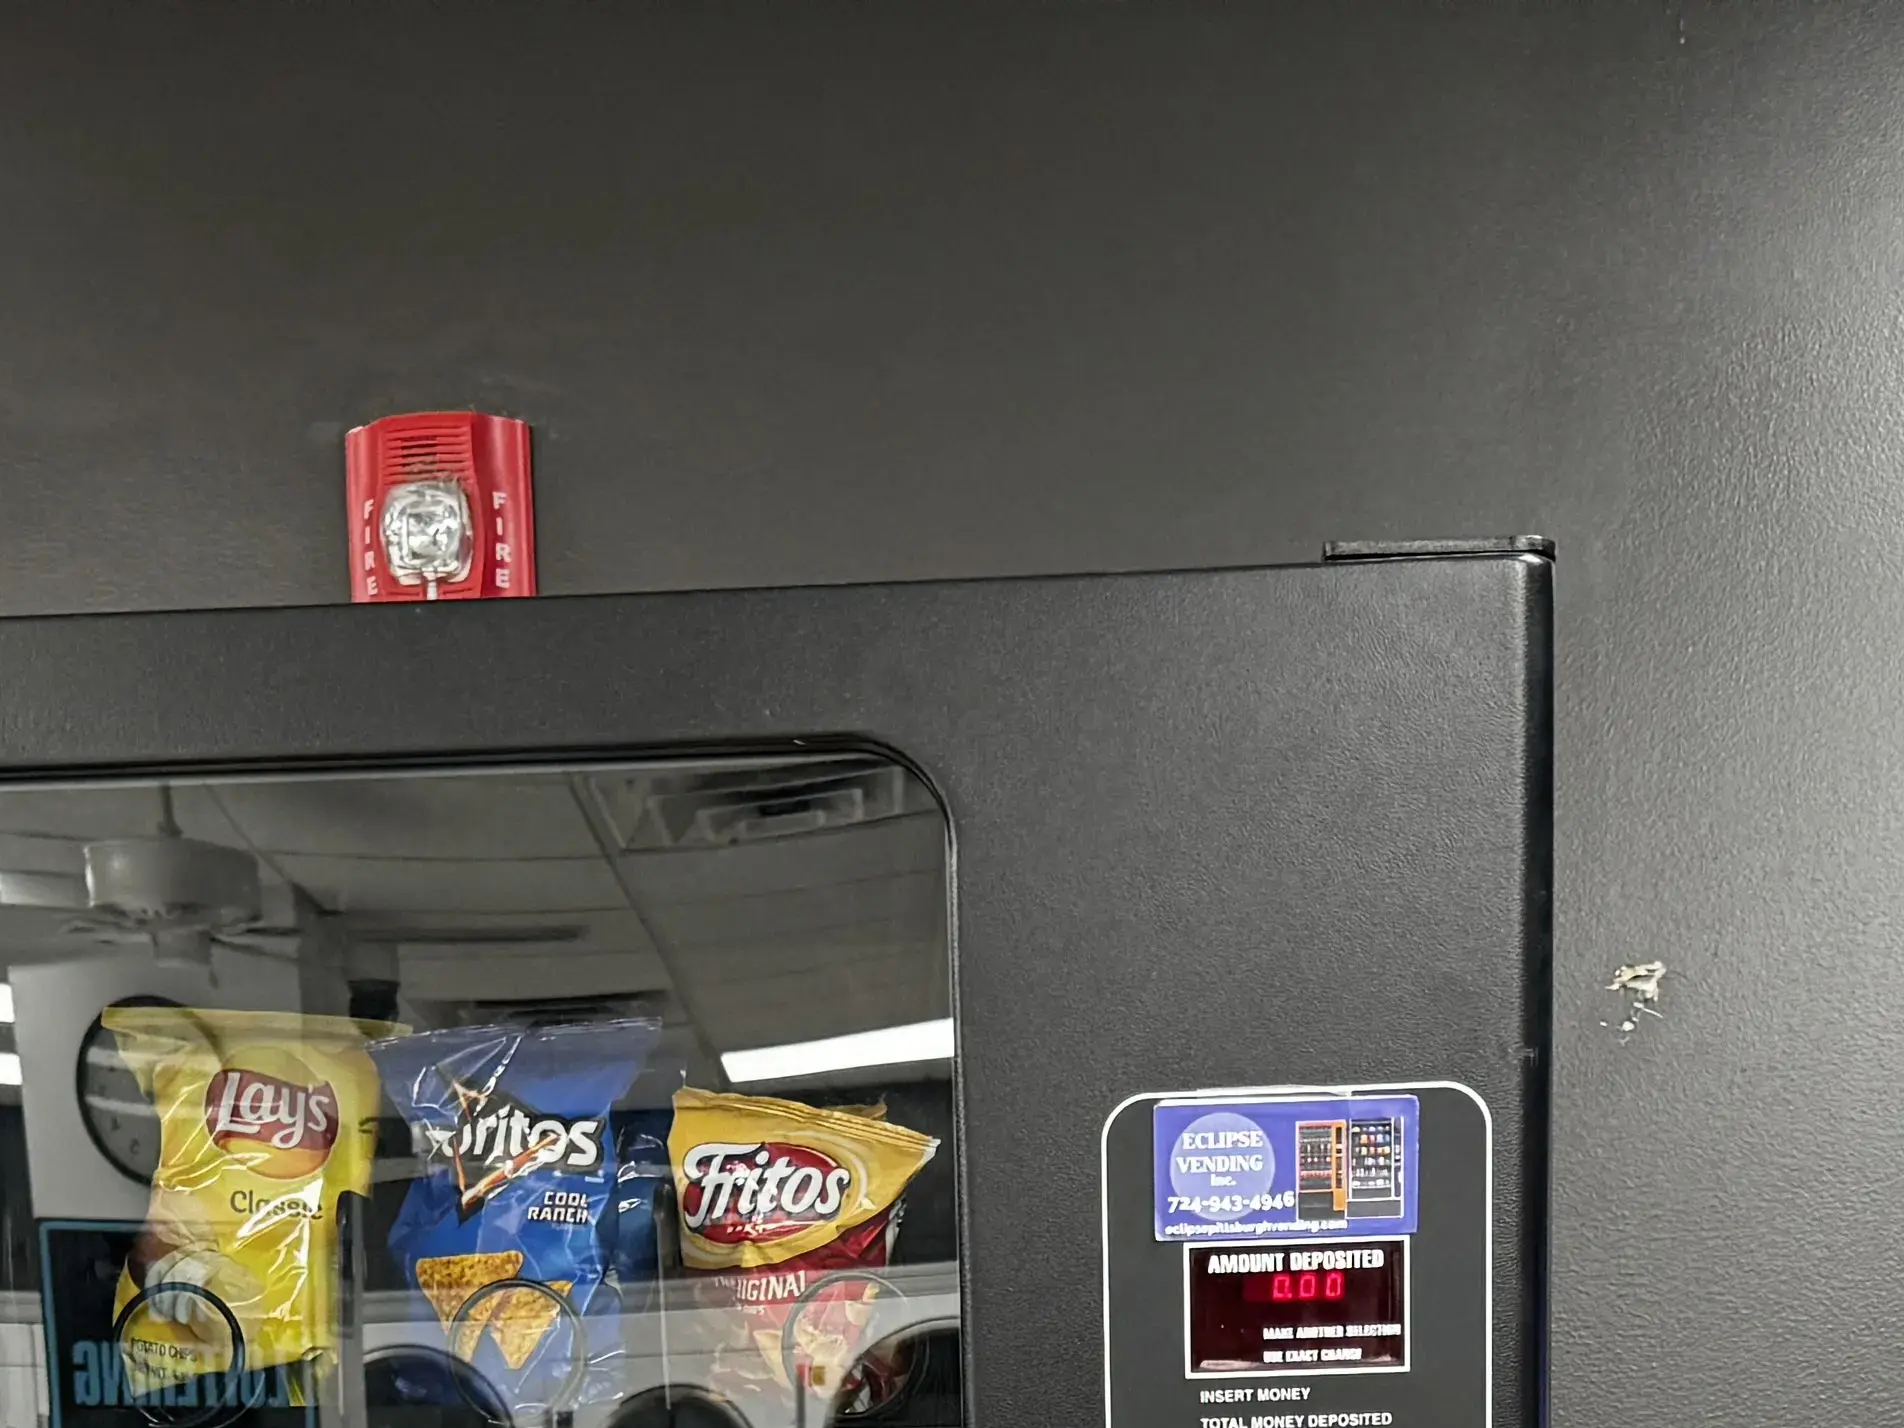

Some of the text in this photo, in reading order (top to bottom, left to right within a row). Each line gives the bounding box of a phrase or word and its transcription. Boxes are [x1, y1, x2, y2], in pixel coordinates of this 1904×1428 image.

[363, 499, 379, 596] FIRE
[492, 491, 512, 589] FIRE
[216, 1071, 330, 1149] Lay's
[1182, 1130, 1264, 1151] ECLIPSE
[1176, 1155, 1264, 1174] VENDING
[683, 1141, 850, 1228] Fritos
[1211, 1174, 1237, 1187] Inc.
[543, 1191, 588, 1207] COOL
[1167, 1191, 1295, 1214] 724-943-4946
[528, 1207, 588, 1223] RANCH
[1208, 1250, 1384, 1274] AMOUNT DEPOSITED
[1263, 1323, 1402, 1340] MAKE ANOTHER SELECTION
[1263, 1348, 1362, 1363] USE EXACT CHANGE
[1200, 1386, 1311, 1405] INSERT MONEY
[1308, 1412, 1393, 1428] DEPOSITED
